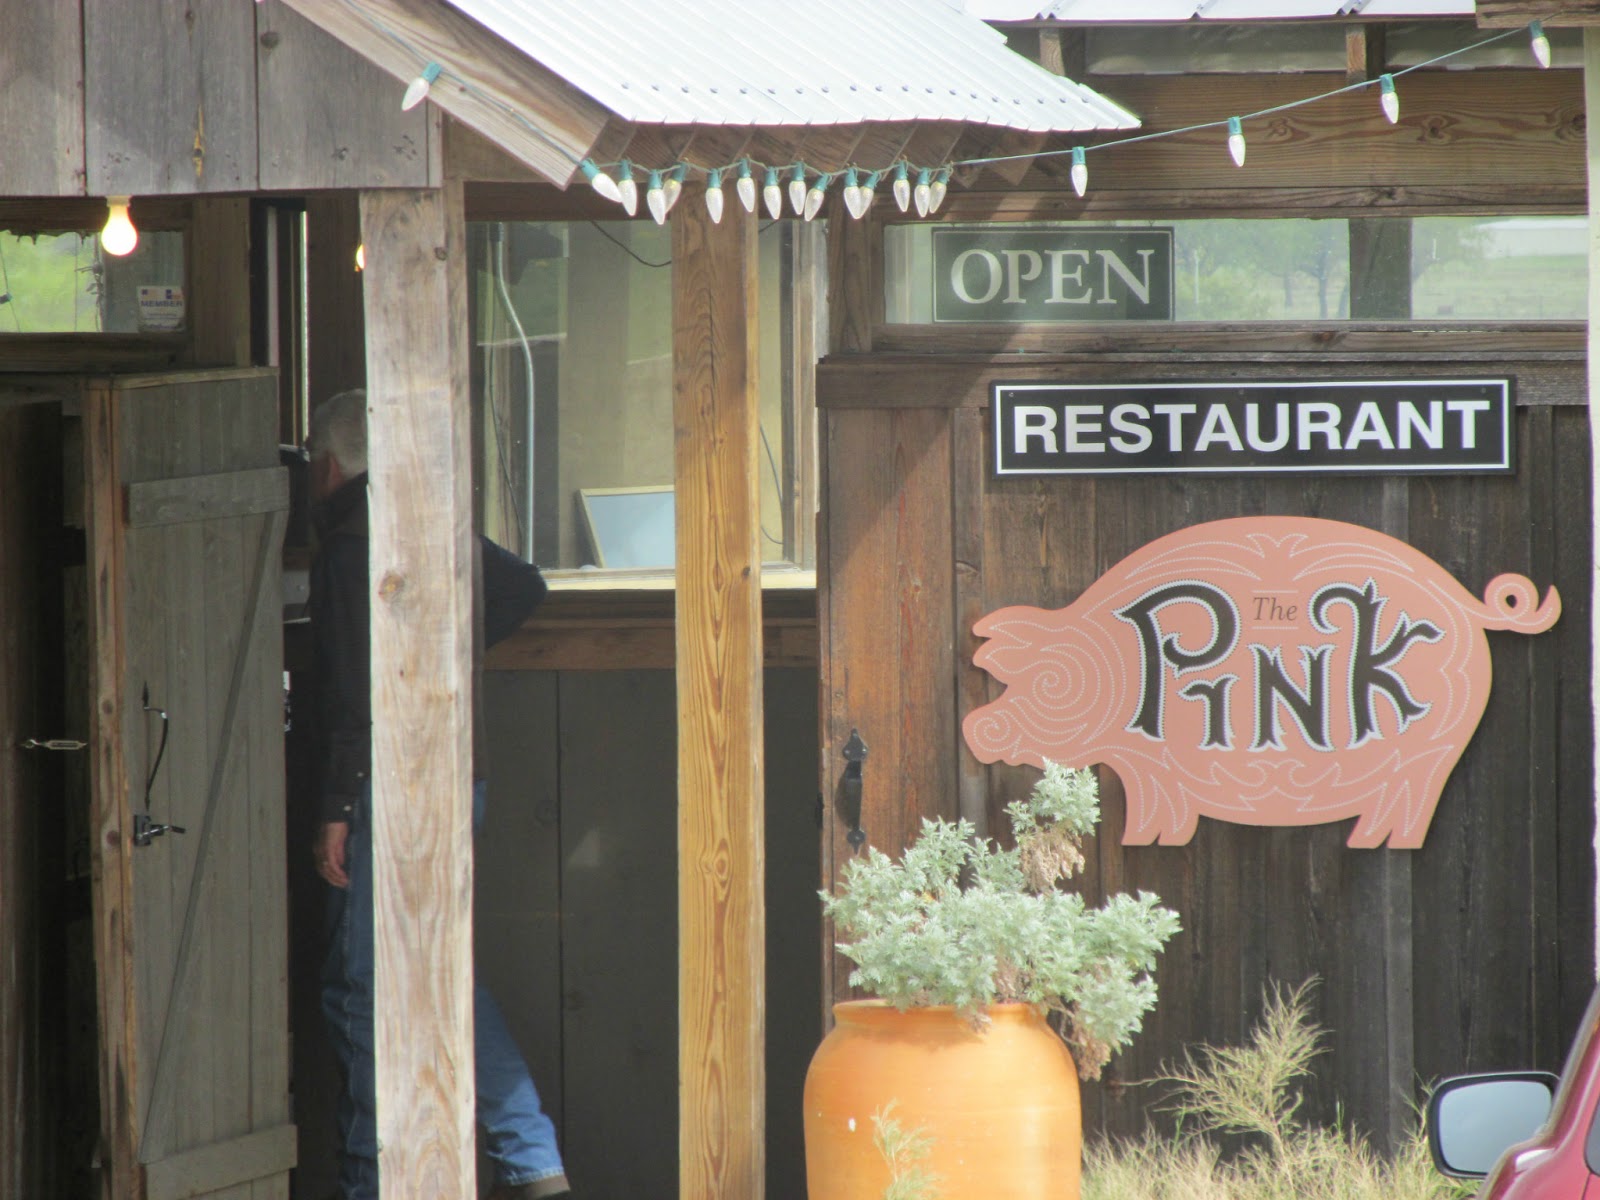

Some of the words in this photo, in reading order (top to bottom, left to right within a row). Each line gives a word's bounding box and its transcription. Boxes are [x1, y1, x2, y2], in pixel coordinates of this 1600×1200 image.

[950, 249, 1155, 304] OPEN
[1013, 400, 1491, 454] RESTAURANT
[1252, 596, 1298, 622] The
